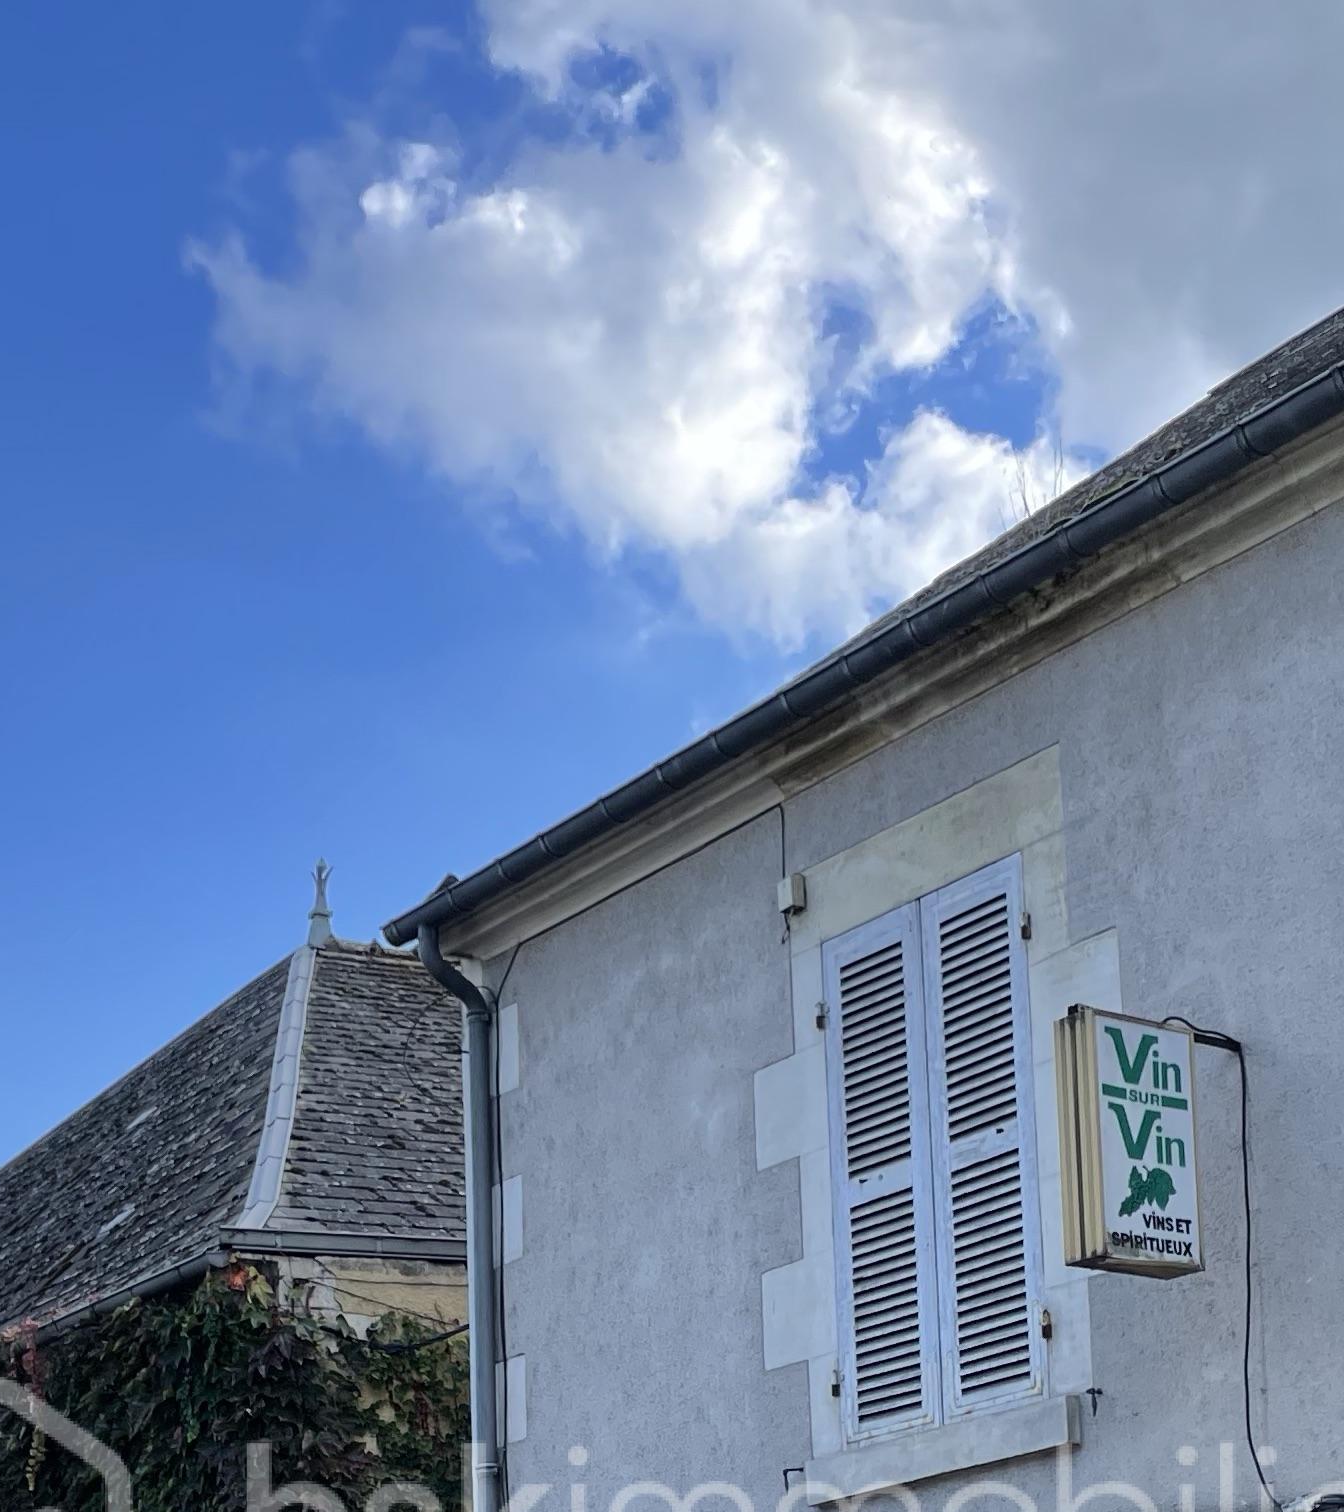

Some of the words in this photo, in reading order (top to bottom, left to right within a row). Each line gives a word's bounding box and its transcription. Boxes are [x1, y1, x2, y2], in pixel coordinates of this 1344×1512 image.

[1104, 1025, 1182, 1093] Vin
[1128, 1089, 1161, 1106] SUR
[1107, 1101, 1186, 1168] Vin
[1142, 1211, 1174, 1232] VINS
[1175, 1218, 1192, 1235] ET
[1111, 1229, 1193, 1258] SPIRITUEUX
